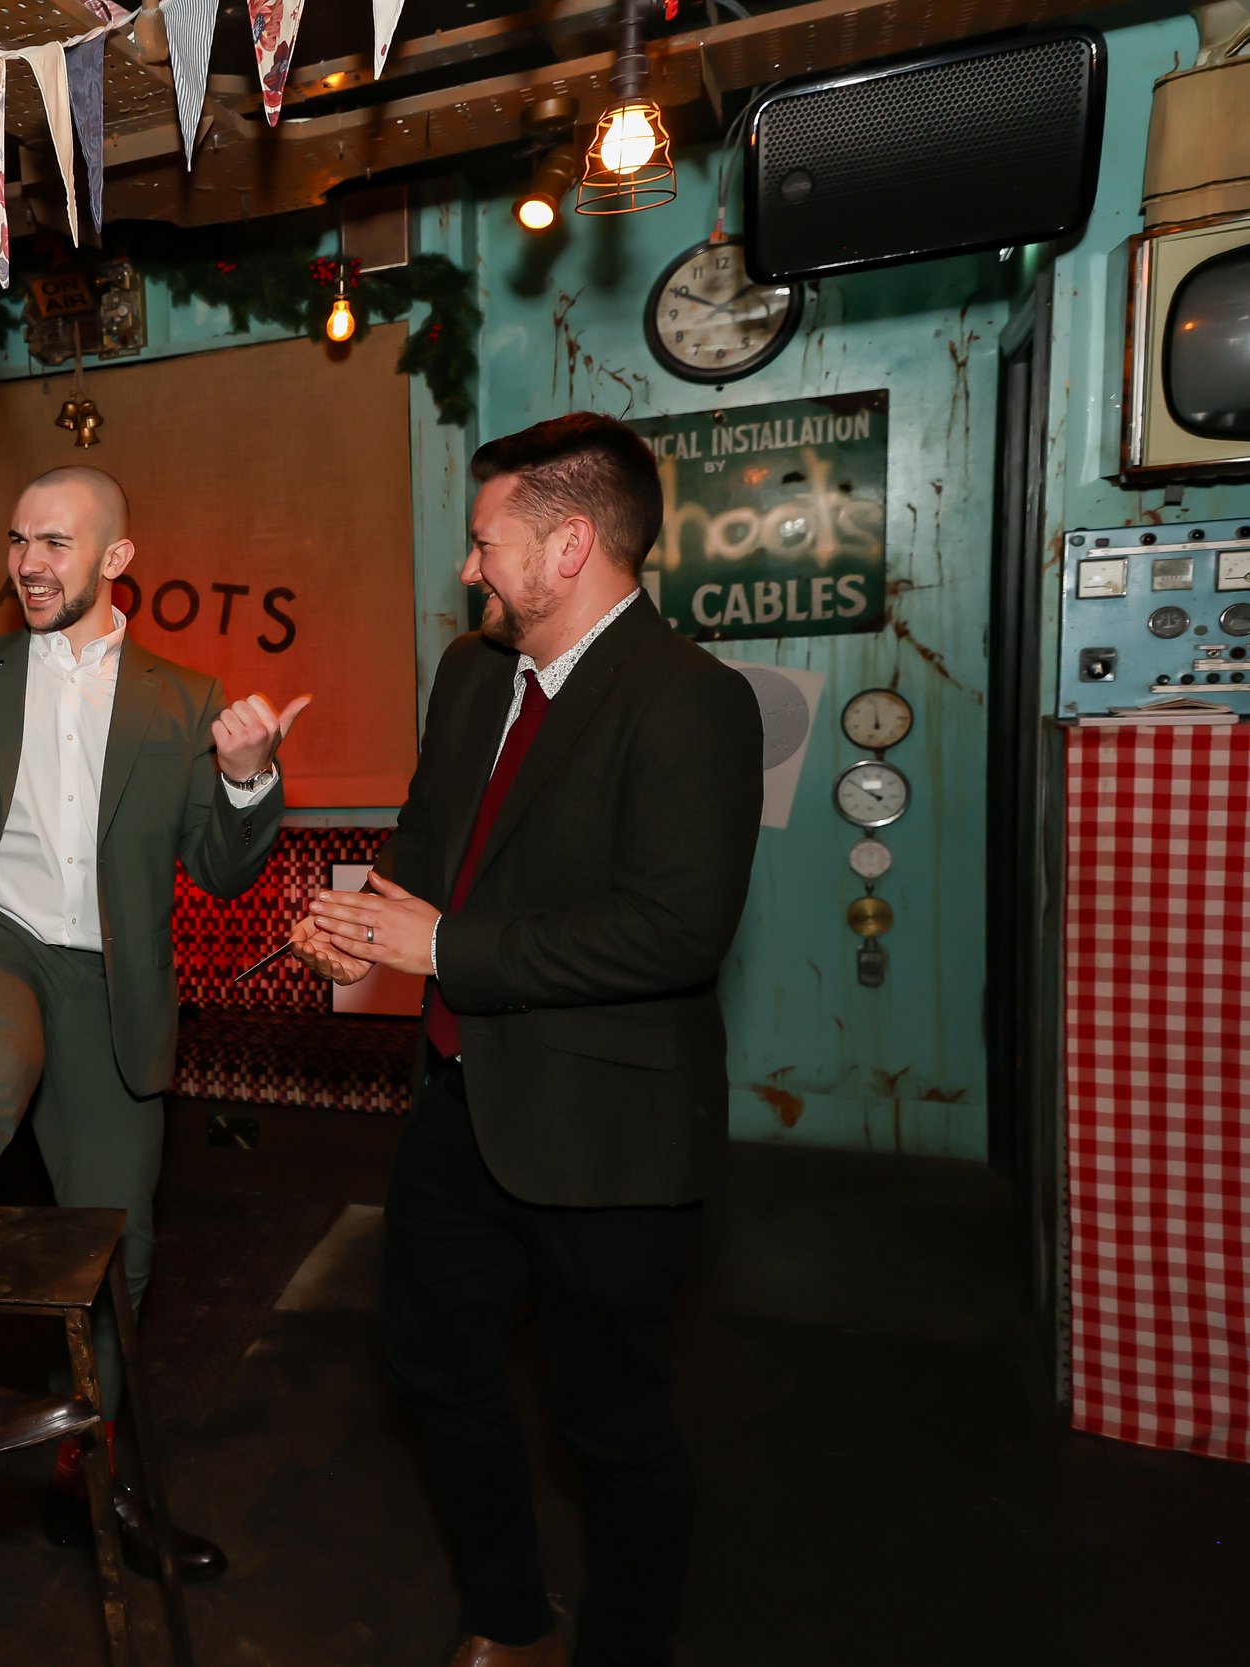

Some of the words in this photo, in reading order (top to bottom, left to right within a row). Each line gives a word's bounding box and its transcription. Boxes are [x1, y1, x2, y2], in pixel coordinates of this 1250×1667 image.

[715, 257, 729, 270] 12
[693, 268, 703, 280] 11
[42, 279, 78, 296] ON
[47, 294, 87, 312] AIR
[670, 309, 678, 321] 9
[675, 331, 684, 343] 8
[741, 337, 750, 350] 5
[693, 344, 701, 356] 7
[716, 348, 725, 360] 6
[711, 408, 871, 456] INSTALLATION
[704, 460, 727, 473] BY
[642, 448, 884, 573] hoots
[691, 574, 868, 628] CABLES
